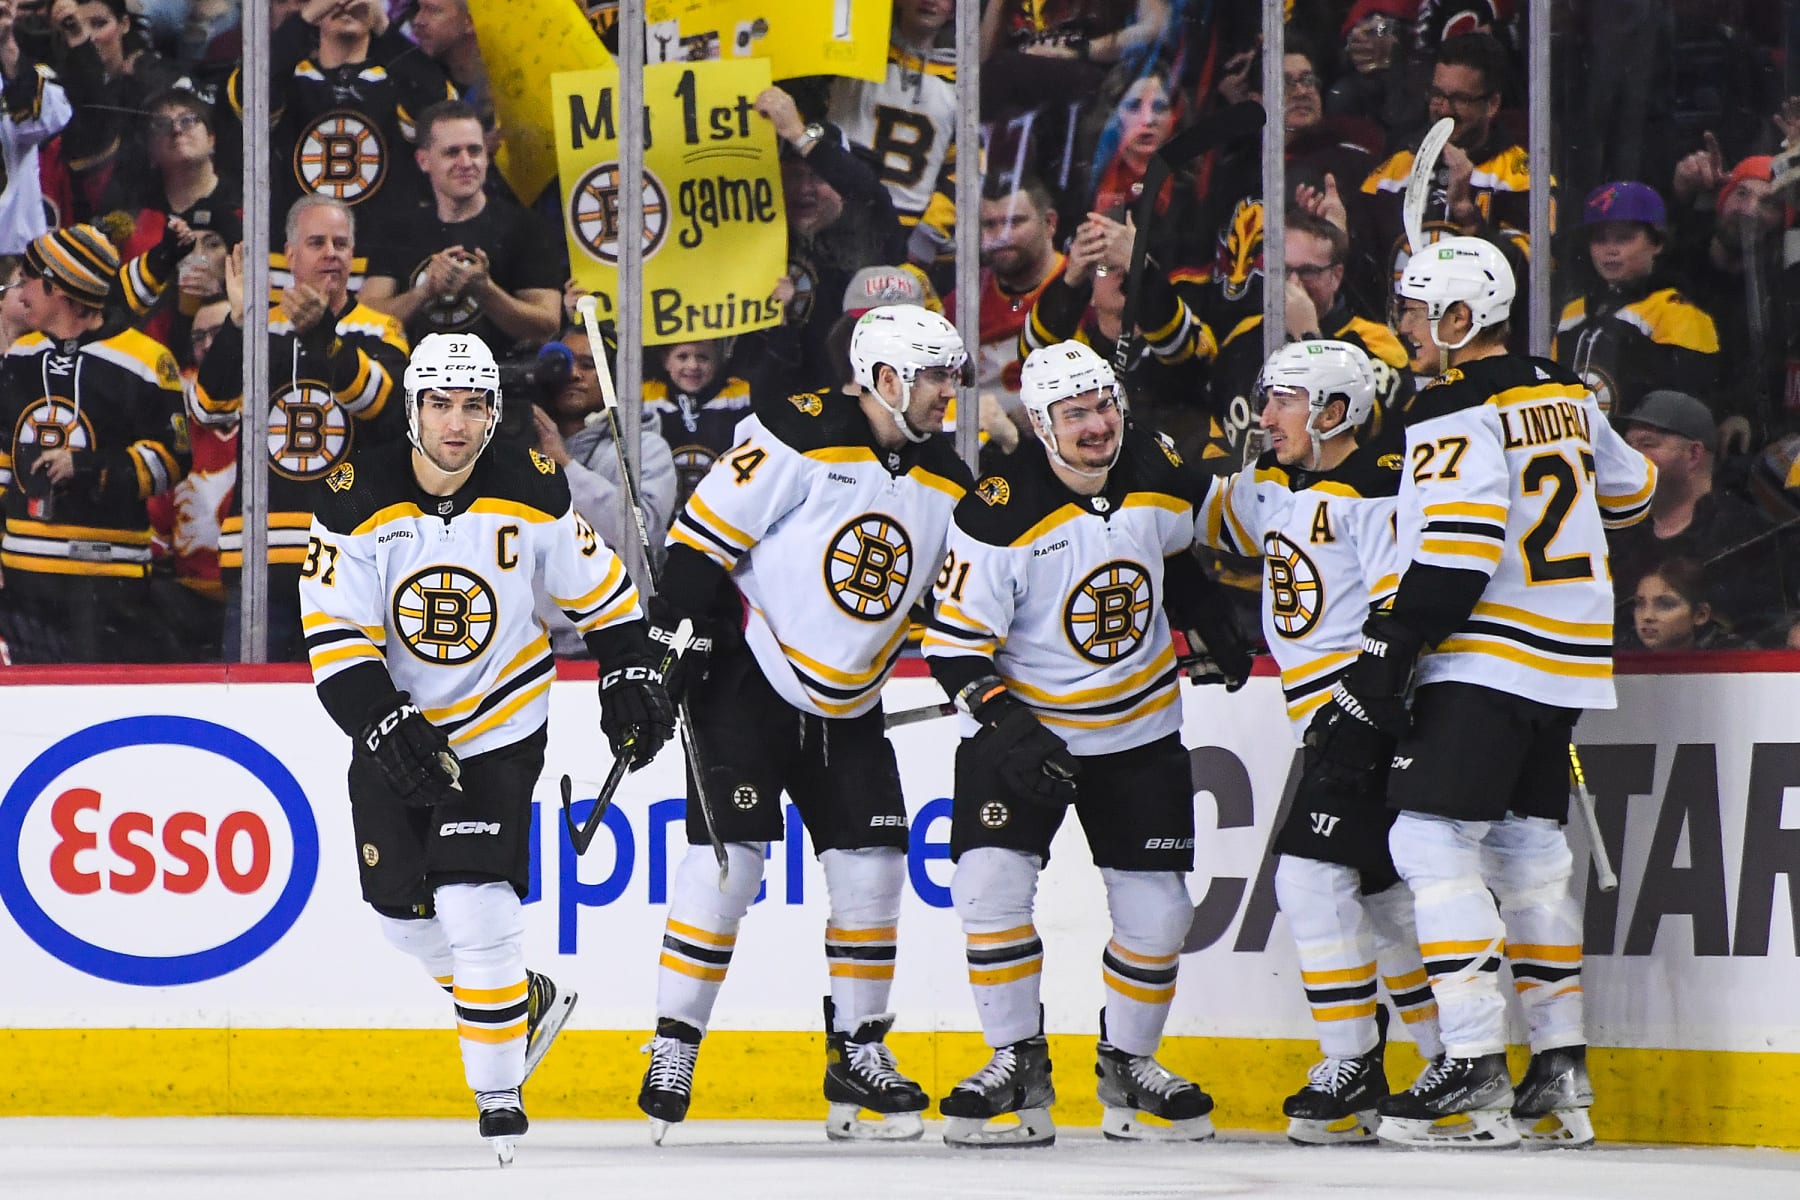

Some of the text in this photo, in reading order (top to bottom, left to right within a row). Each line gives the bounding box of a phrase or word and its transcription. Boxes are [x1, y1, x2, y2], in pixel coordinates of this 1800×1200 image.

[674, 70, 757, 145] 1st
[679, 175, 777, 248] game
[651, 288, 780, 336] Bruins
[449, 343, 468, 353] 37
[1065, 350, 1083, 361] 81
[1411, 435, 1471, 486] 27
[496, 524, 519, 571] C
[1310, 500, 1336, 544] A
[300, 535, 341, 588] 37
[844, 532, 898, 601] B
[936, 549, 971, 604] 81
[418, 586, 471, 646] B
[1091, 581, 1136, 647] B
[602, 666, 664, 691] CCM
[366, 704, 420, 752] CCM
[50, 787, 271, 895] Esso
[439, 821, 501, 837] CCM
